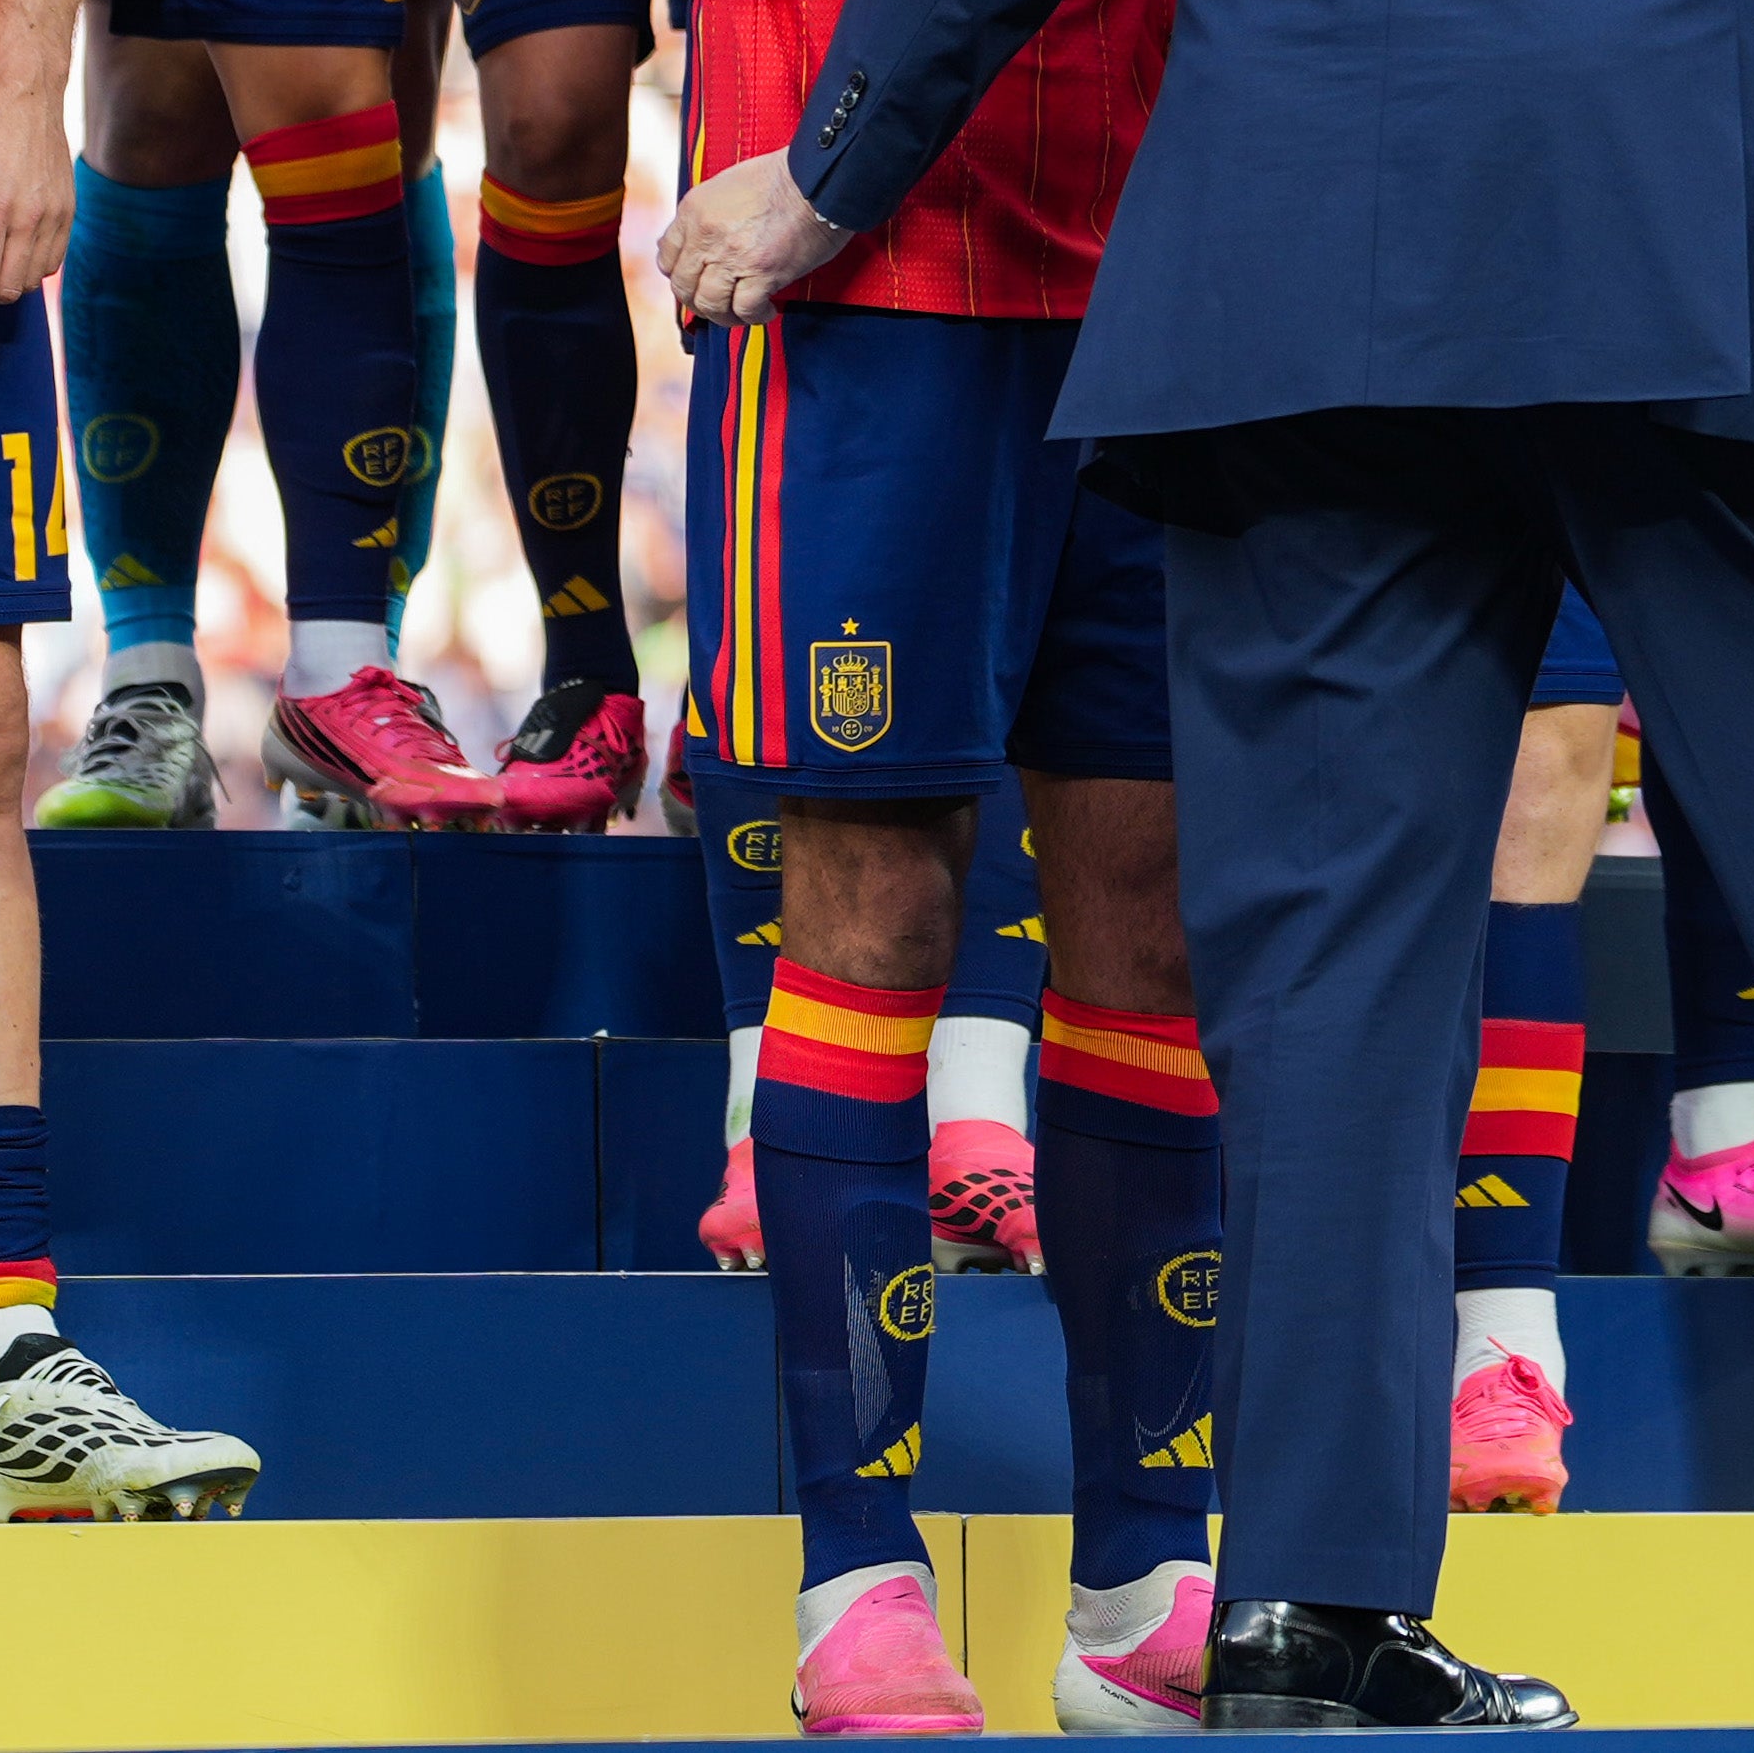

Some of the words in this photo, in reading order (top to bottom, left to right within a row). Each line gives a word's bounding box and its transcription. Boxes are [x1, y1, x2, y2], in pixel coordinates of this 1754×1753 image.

[1182, 1268, 1221, 1288] RF
[1182, 1291, 1219, 1310] EF
[1099, 1683, 1140, 1709] PHANTOM
